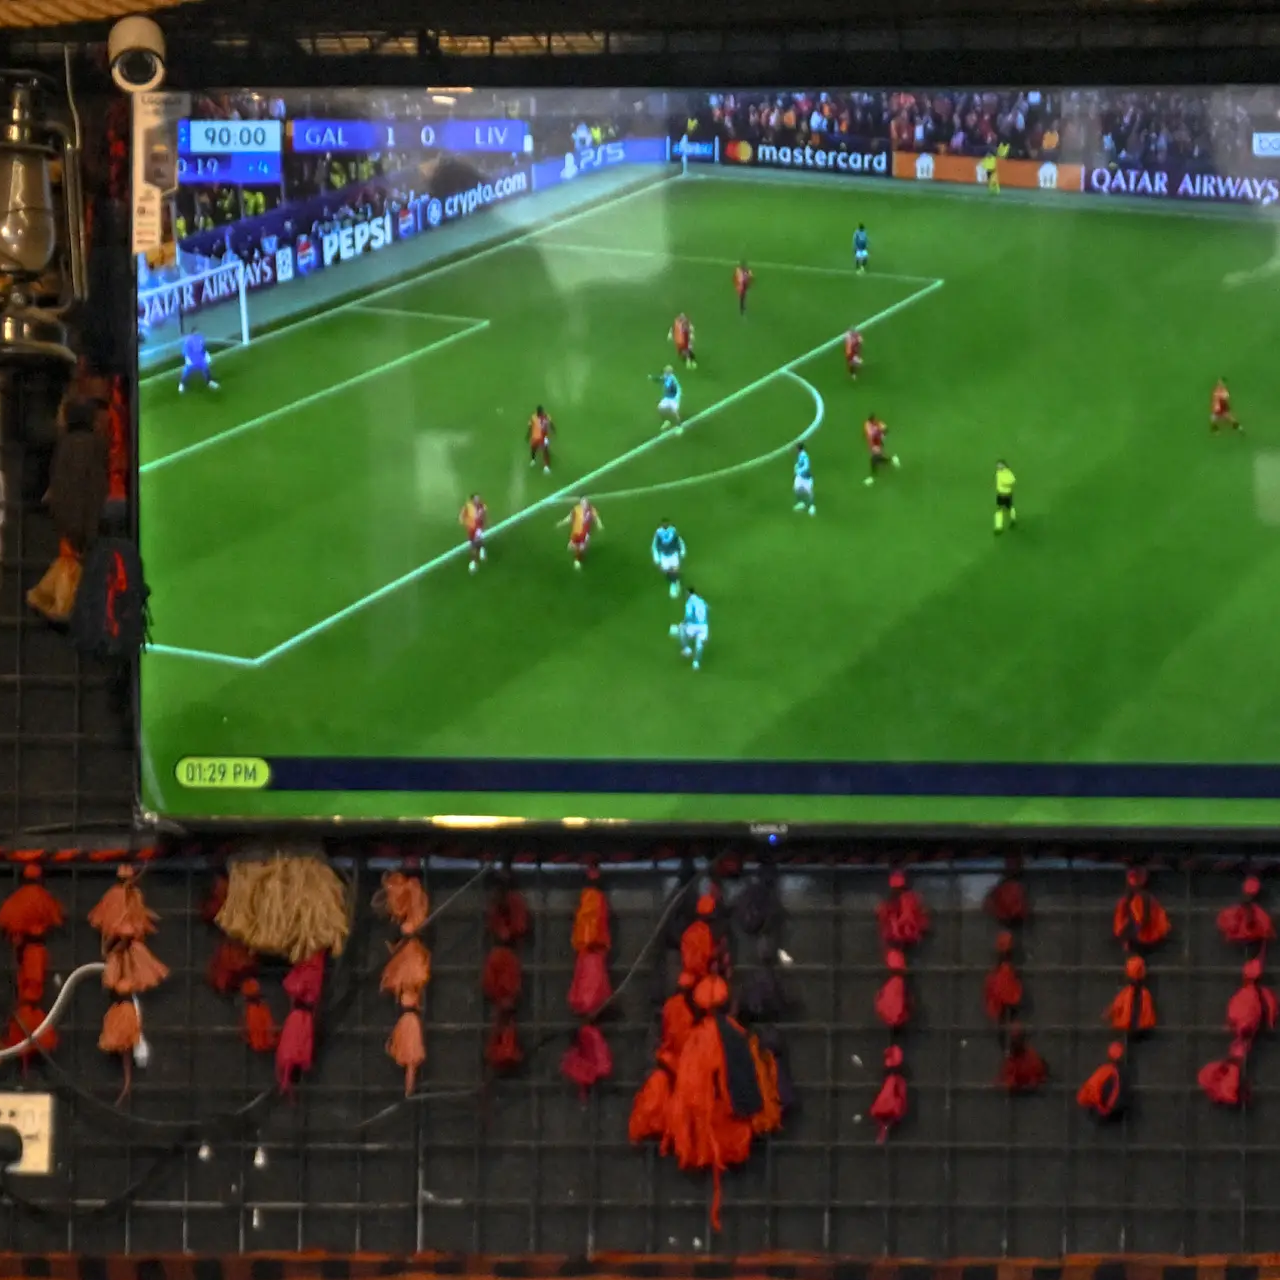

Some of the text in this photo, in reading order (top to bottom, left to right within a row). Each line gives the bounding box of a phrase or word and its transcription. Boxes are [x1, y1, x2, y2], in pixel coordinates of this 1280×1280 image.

[204, 126, 266, 147] 90:00
[305, 126, 508, 147] GAL 1 0 LIV
[579, 142, 626, 170] PS5
[758, 144, 887, 171] mastercard
[444, 171, 527, 216] crypto.com
[1091, 167, 1279, 203] QATAR AIRWAYS
[322, 210, 392, 267] PEPSI
[186, 763, 258, 783] 01:29 PM
